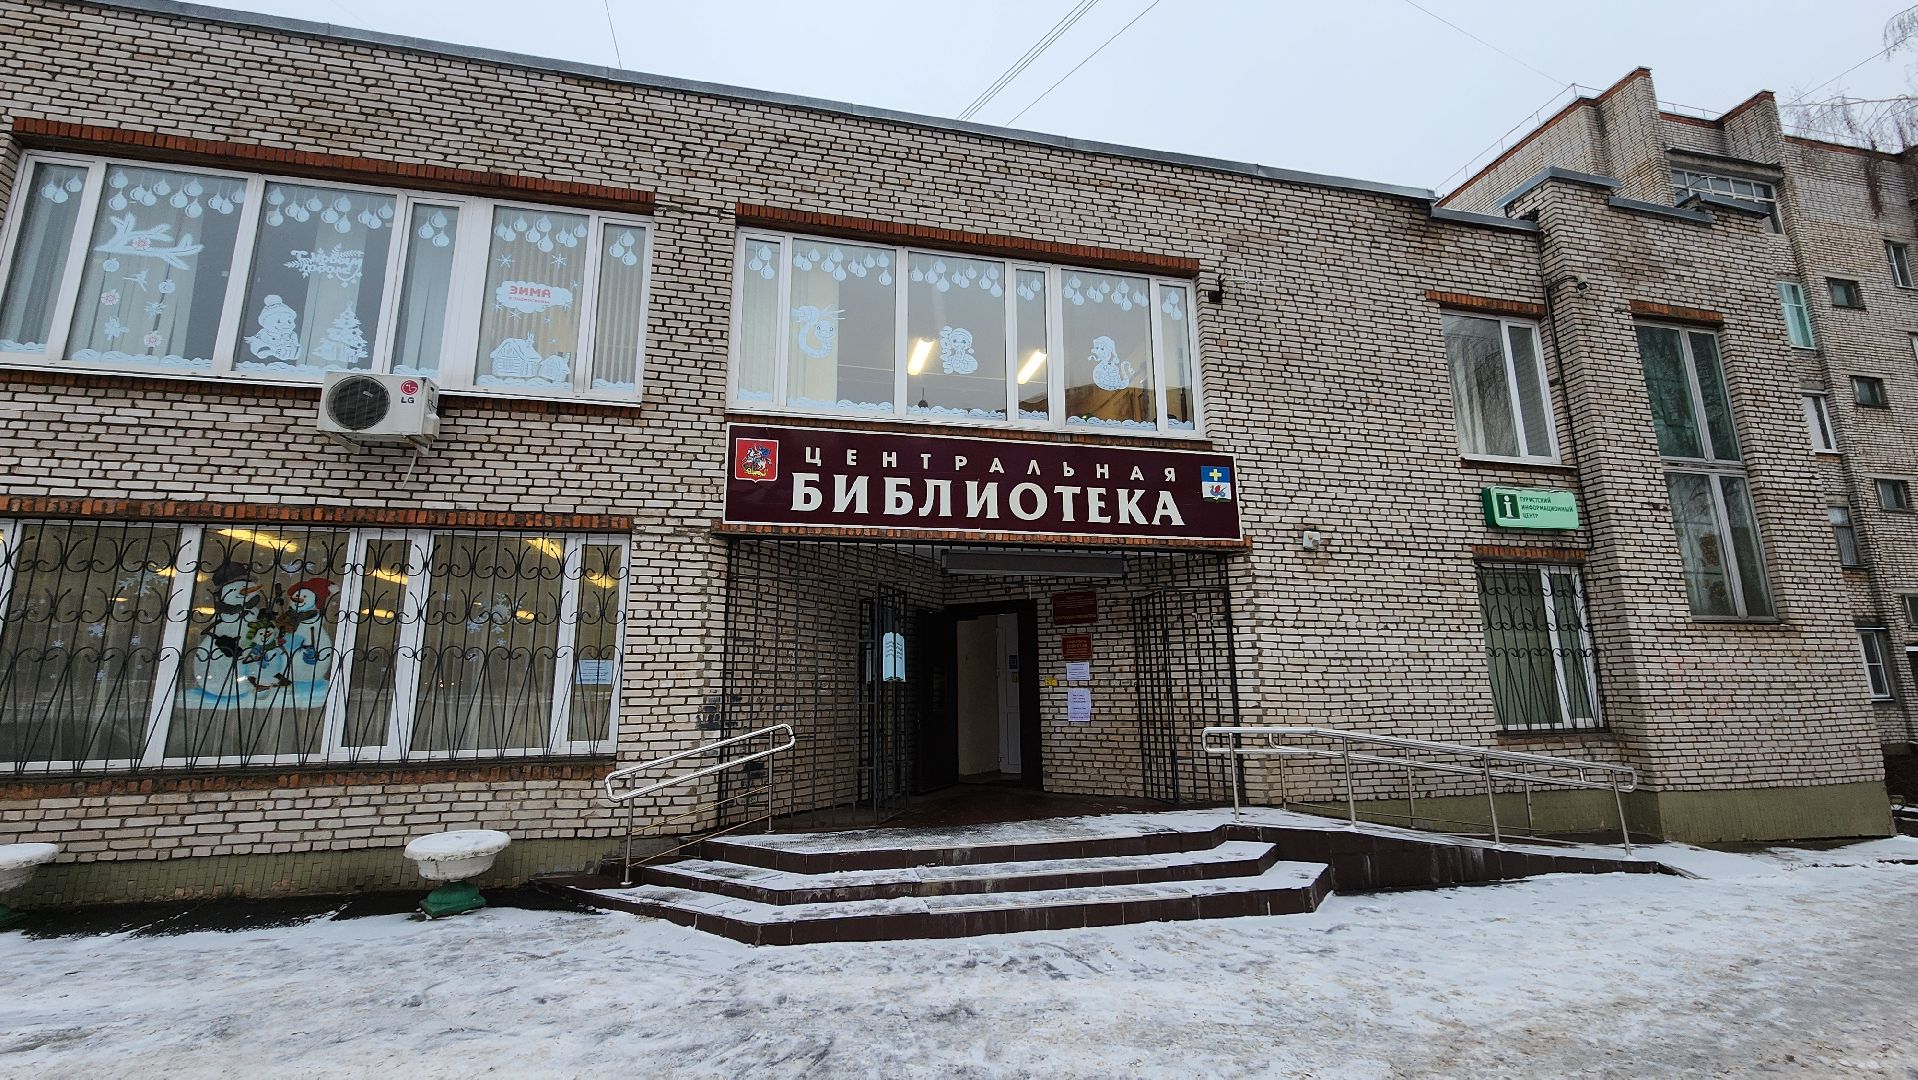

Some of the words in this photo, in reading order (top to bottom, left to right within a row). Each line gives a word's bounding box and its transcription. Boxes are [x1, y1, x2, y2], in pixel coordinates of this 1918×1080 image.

[508, 285, 551, 299] ЗИМА
[401, 396, 415, 404] LG
[804, 446, 1177, 483] ЦЕНТРАЛЬНАЯ
[790, 471, 1186, 526] БИБЛИОТЕКА
[1521, 504, 1574, 513] ИНФОРМАЦИОННЫЙ
